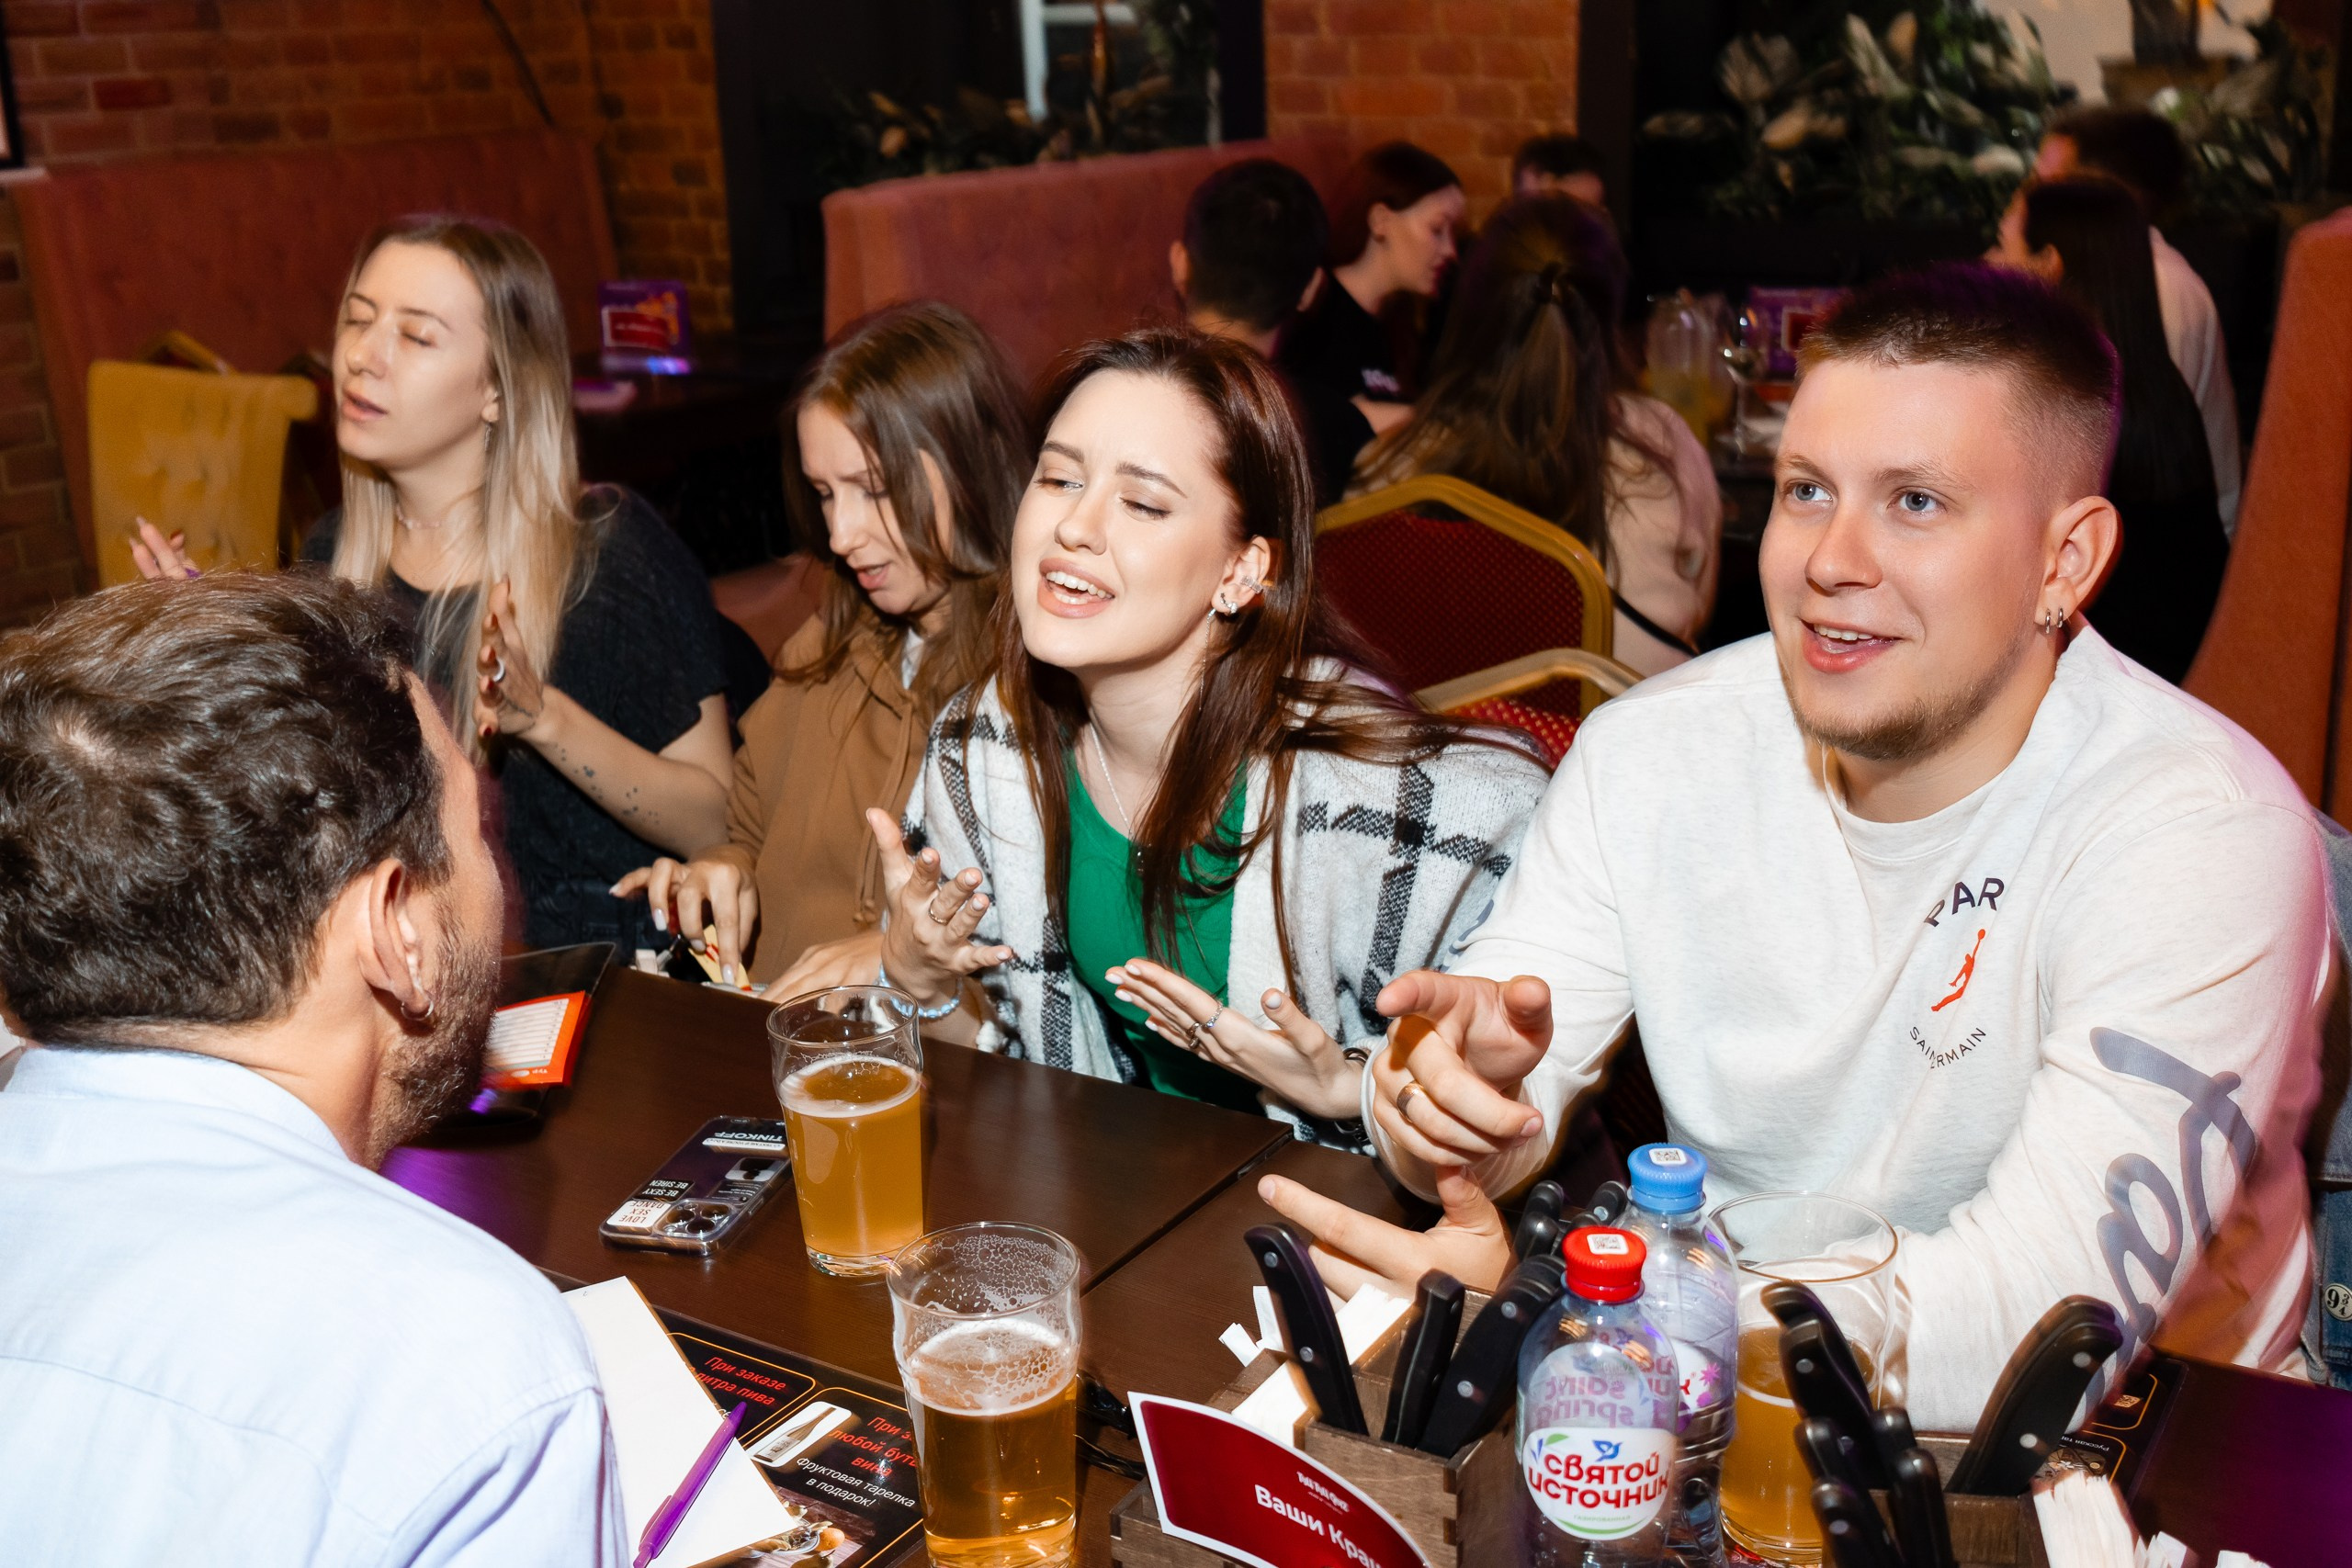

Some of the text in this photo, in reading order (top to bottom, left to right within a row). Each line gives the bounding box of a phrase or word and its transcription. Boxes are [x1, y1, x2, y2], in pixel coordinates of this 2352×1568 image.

[714, 1131, 783, 1143] TINKOFF
[642, 1188, 667, 1197] SEXY
[650, 1179, 673, 1189] SIREN
[618, 1214, 646, 1224] LOVE
[705, 1356, 786, 1392] При заказе
[738, 1386, 775, 1405] пива
[867, 1416, 901, 1434] При
[830, 1429, 885, 1453] любой
[851, 1456, 892, 1477] вина
[796, 1457, 916, 1507] Фруктовая тарелка
[816, 1482, 876, 1507] подарок!
[1255, 1484, 1325, 1537] Ваши
